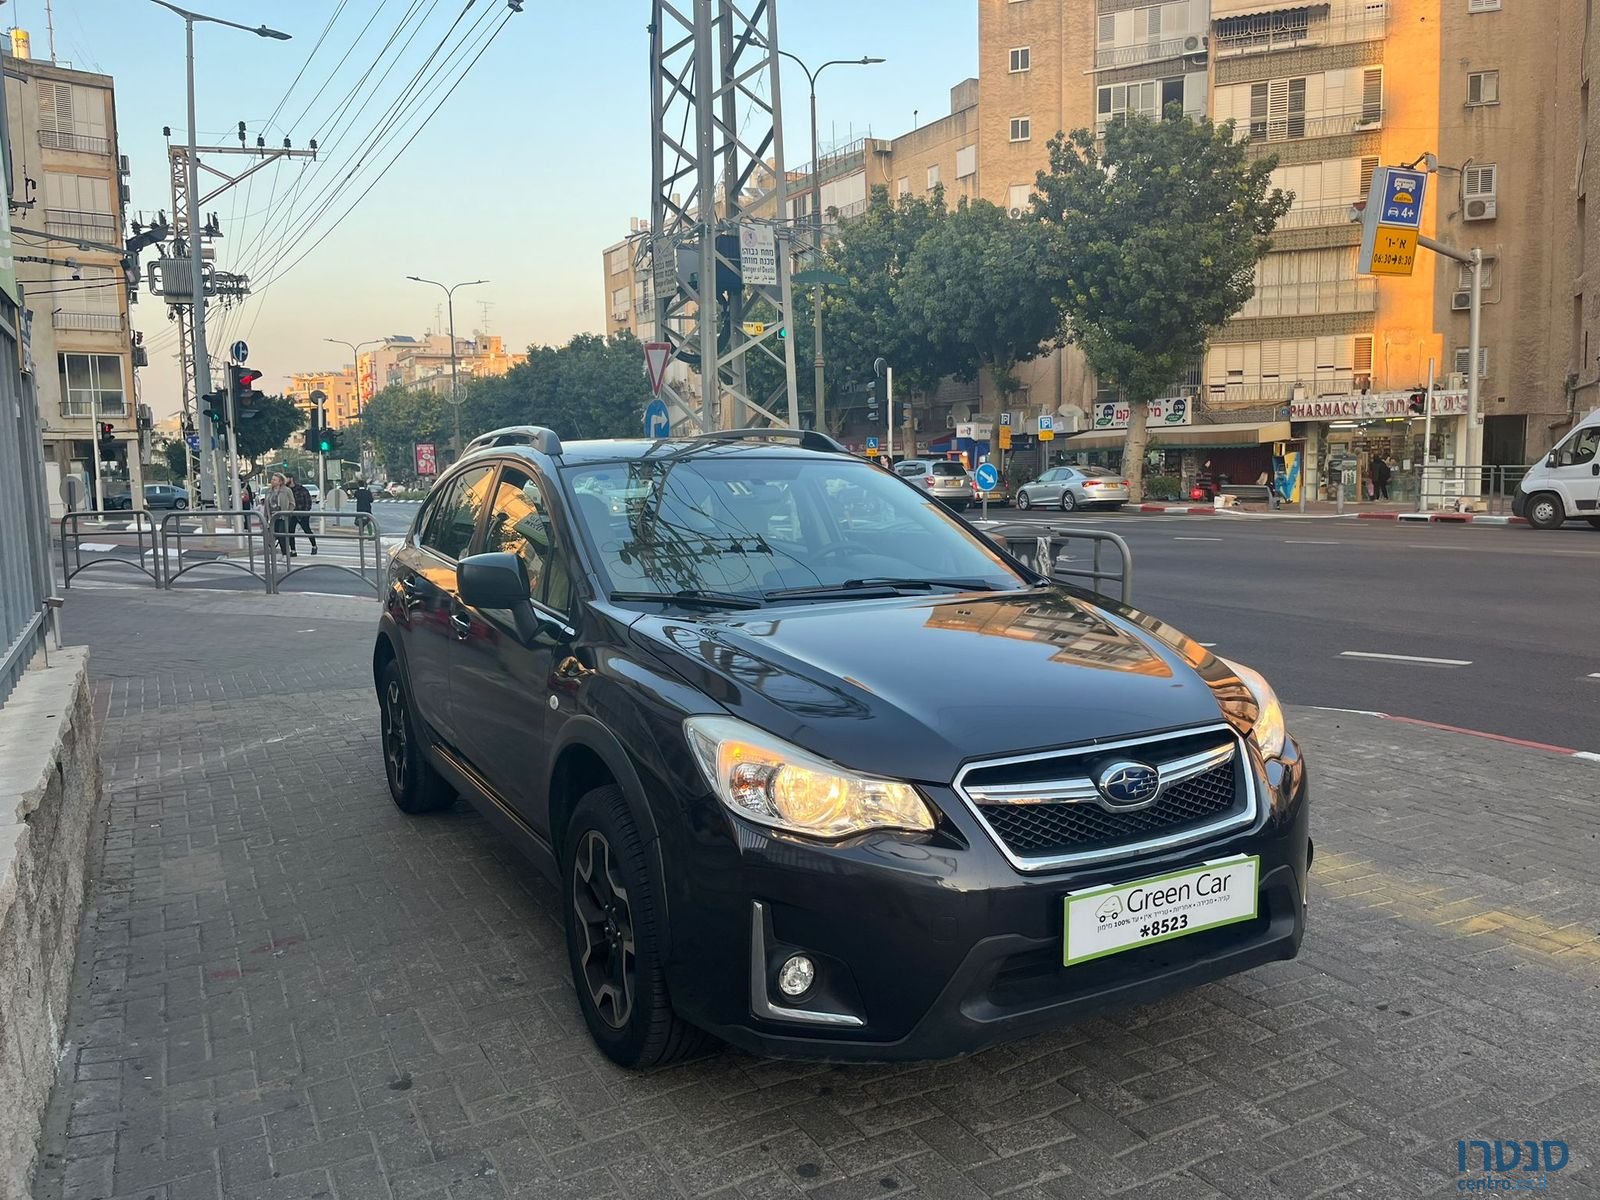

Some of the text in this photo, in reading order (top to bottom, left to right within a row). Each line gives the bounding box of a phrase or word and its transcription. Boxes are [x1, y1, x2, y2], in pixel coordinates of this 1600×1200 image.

[1401, 207, 1414, 218] 4+
[1373, 253, 1412, 266] 06:30 8:30
[1290, 401, 1359, 419] PHARMACY
[1127, 873, 1231, 913] Green Car
[1114, 918, 1131, 928] 100%
